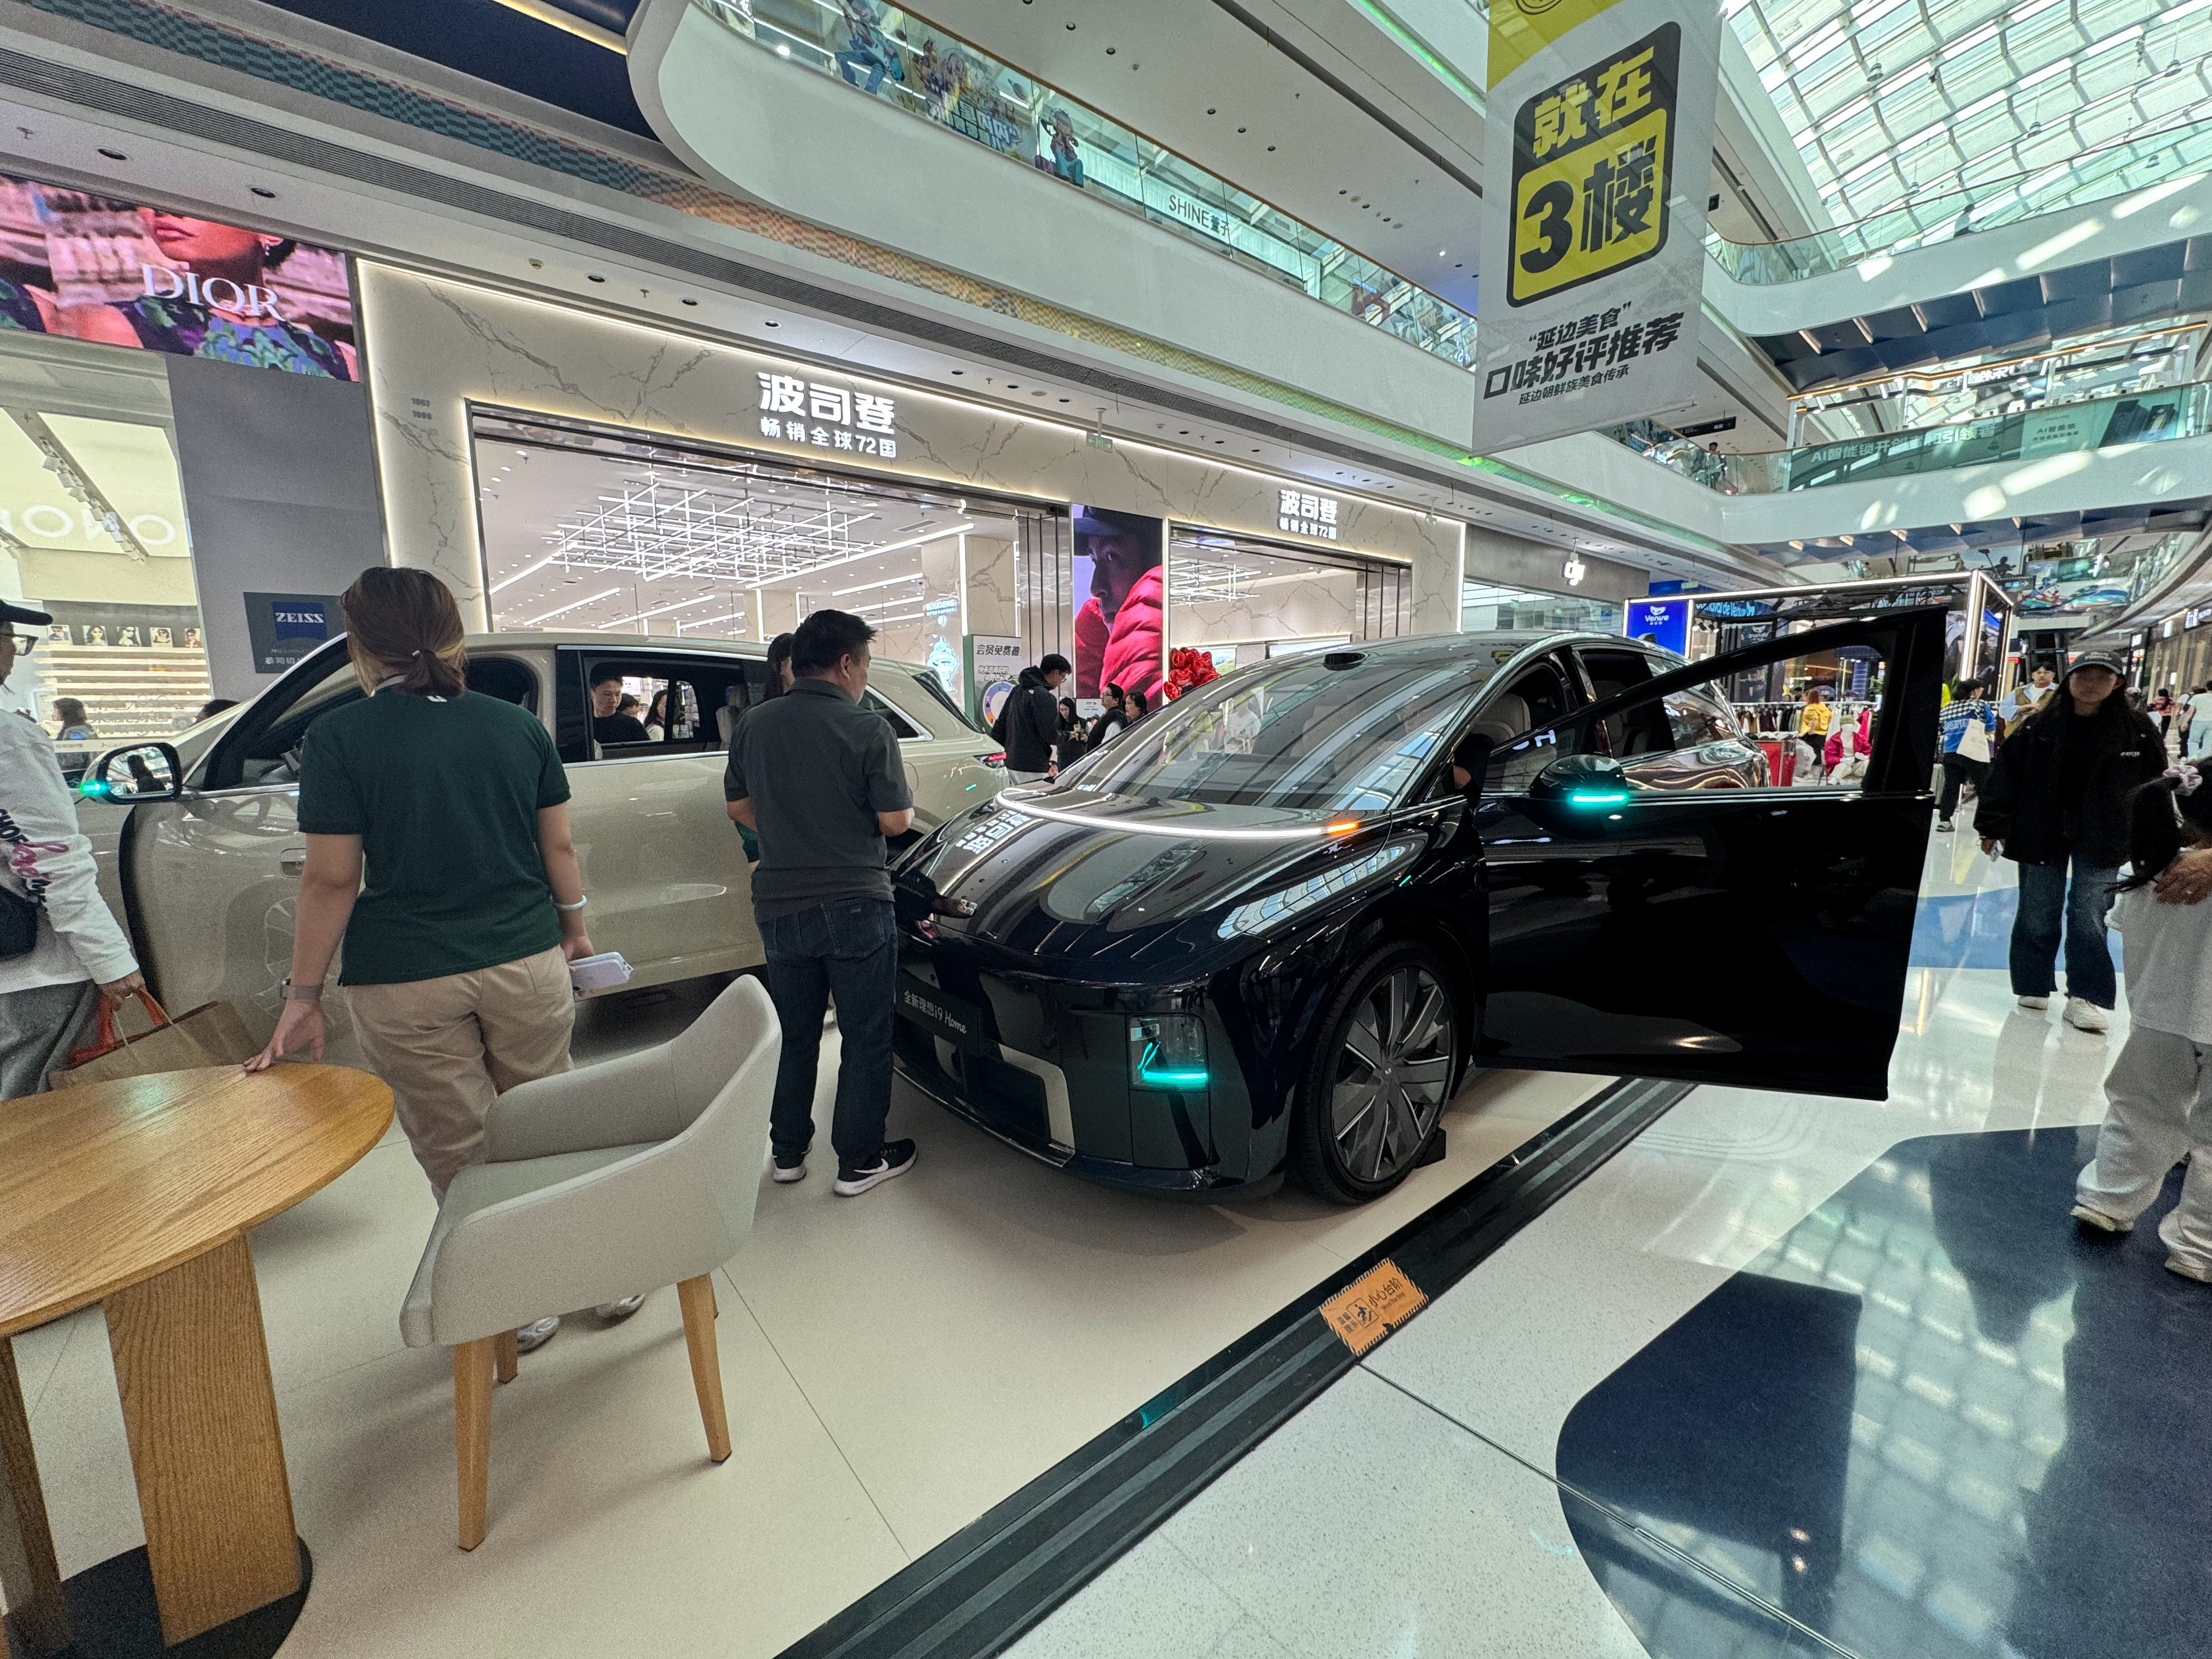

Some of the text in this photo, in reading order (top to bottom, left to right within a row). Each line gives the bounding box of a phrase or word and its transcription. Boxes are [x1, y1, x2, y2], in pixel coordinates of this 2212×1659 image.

[1533, 46, 1654, 159] 就在
[1520, 135, 1657, 273] 3楼
[142, 264, 287, 322] DIOR
[1529, 301, 1632, 352] “延边美食”
[1483, 312, 1684, 399] 口味好评推荐
[757, 372, 895, 435] 波司登
[1518, 364, 1629, 405] 延边朝鲜族美食传承
[760, 416, 897, 458] 畅销全球72国
[1280, 489, 1338, 524] 波司登
[275, 612, 324, 623] ZEISS
[977, 644, 1022, 657] 会员免费抽
[945, 1010, 967, 1034] Home
[1369, 1277, 1403, 1306] 小心台阶
